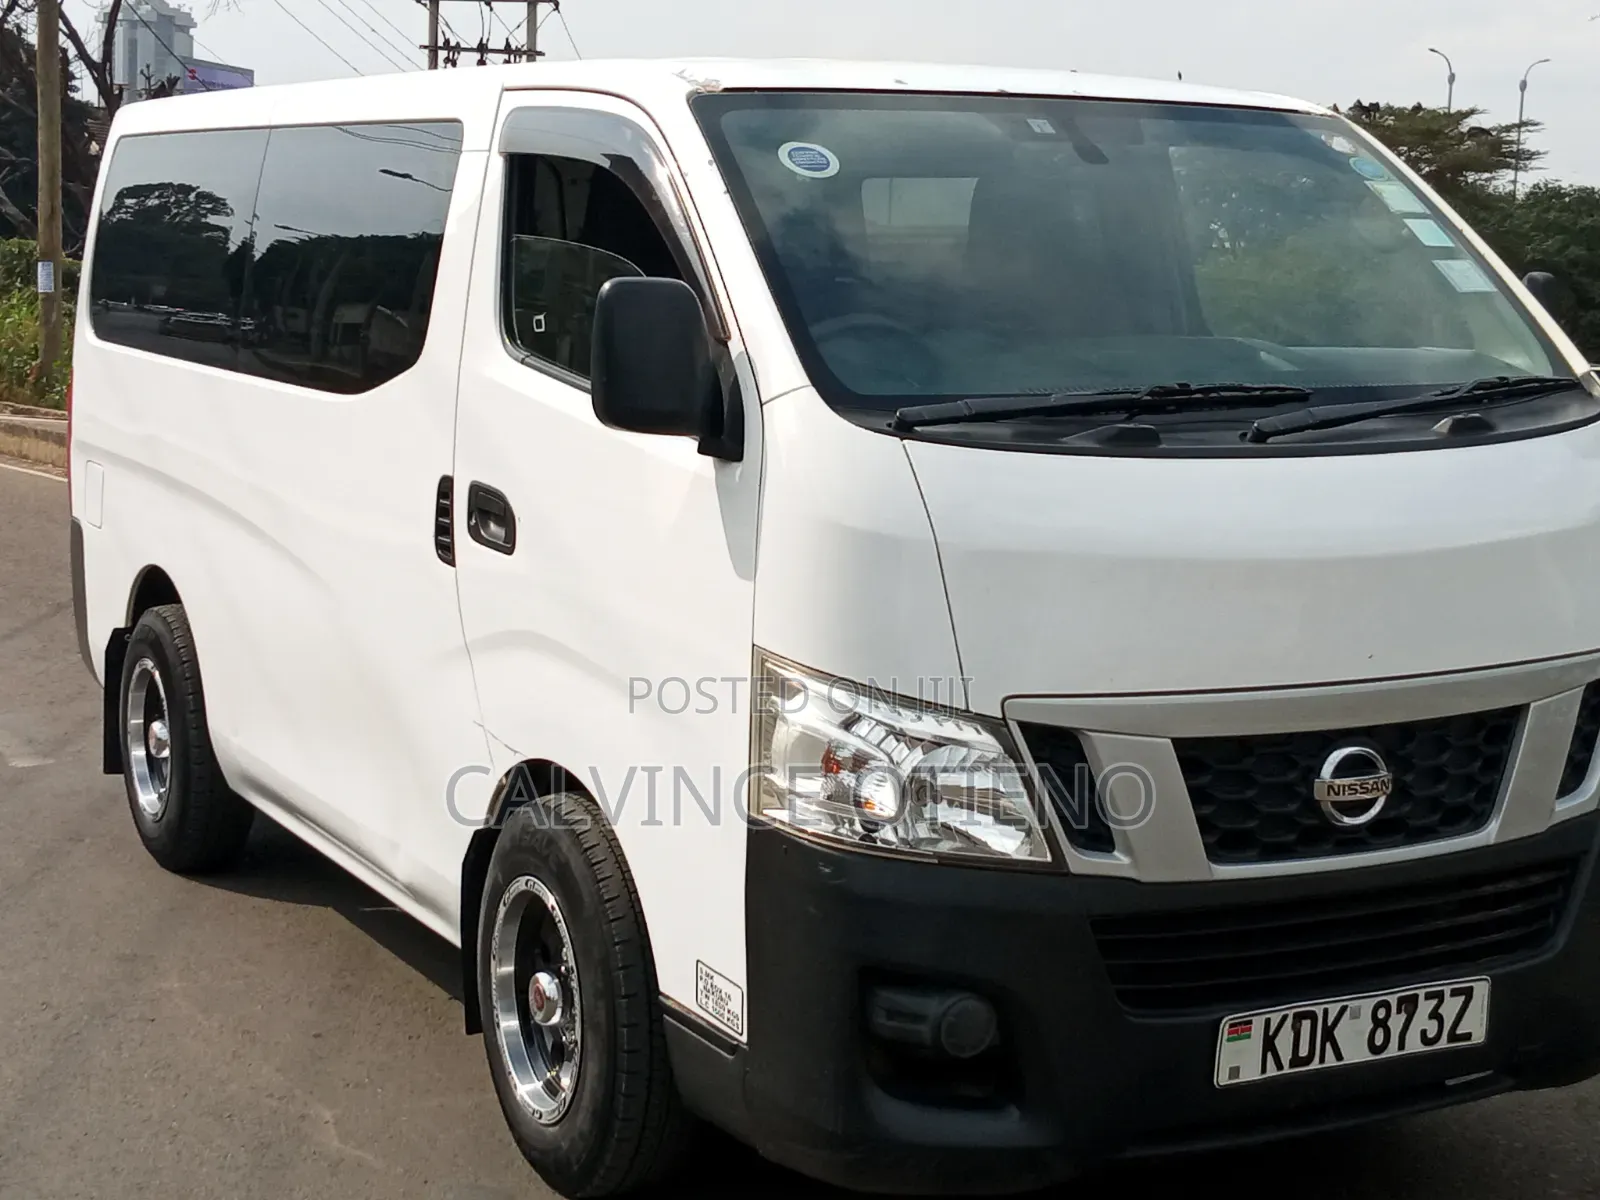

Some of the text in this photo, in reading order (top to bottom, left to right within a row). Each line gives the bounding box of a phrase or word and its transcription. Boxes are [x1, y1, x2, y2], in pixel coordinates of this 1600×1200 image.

[1326, 778, 1390, 797] NISSAN
[1260, 1004, 1349, 1075] KDK
[1367, 985, 1475, 1055] 873Z
